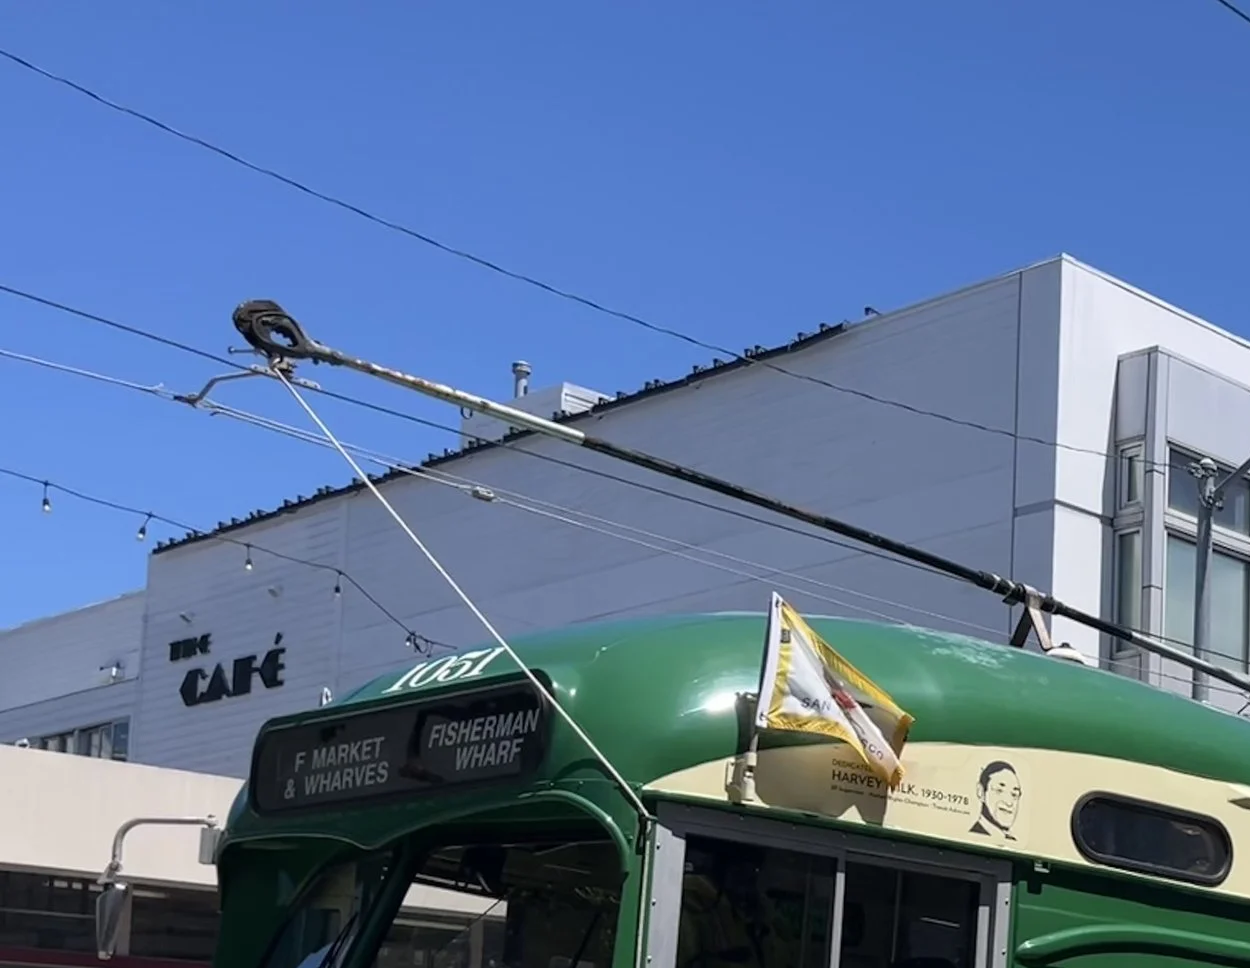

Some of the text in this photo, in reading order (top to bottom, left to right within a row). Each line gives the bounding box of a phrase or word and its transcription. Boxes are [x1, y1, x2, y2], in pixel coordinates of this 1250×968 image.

[169, 632, 211, 661] THE
[179, 631, 286, 707] CAFÉ
[381, 646, 505, 694] 1051
[801, 697, 831, 711] SAN
[428, 708, 540, 748] FISHERMAN
[294, 737, 386, 773] F MARKET
[455, 738, 524, 771] WHARF
[284, 761, 389, 800] & WHARVES
[831, 769, 883, 789] HARVEY
